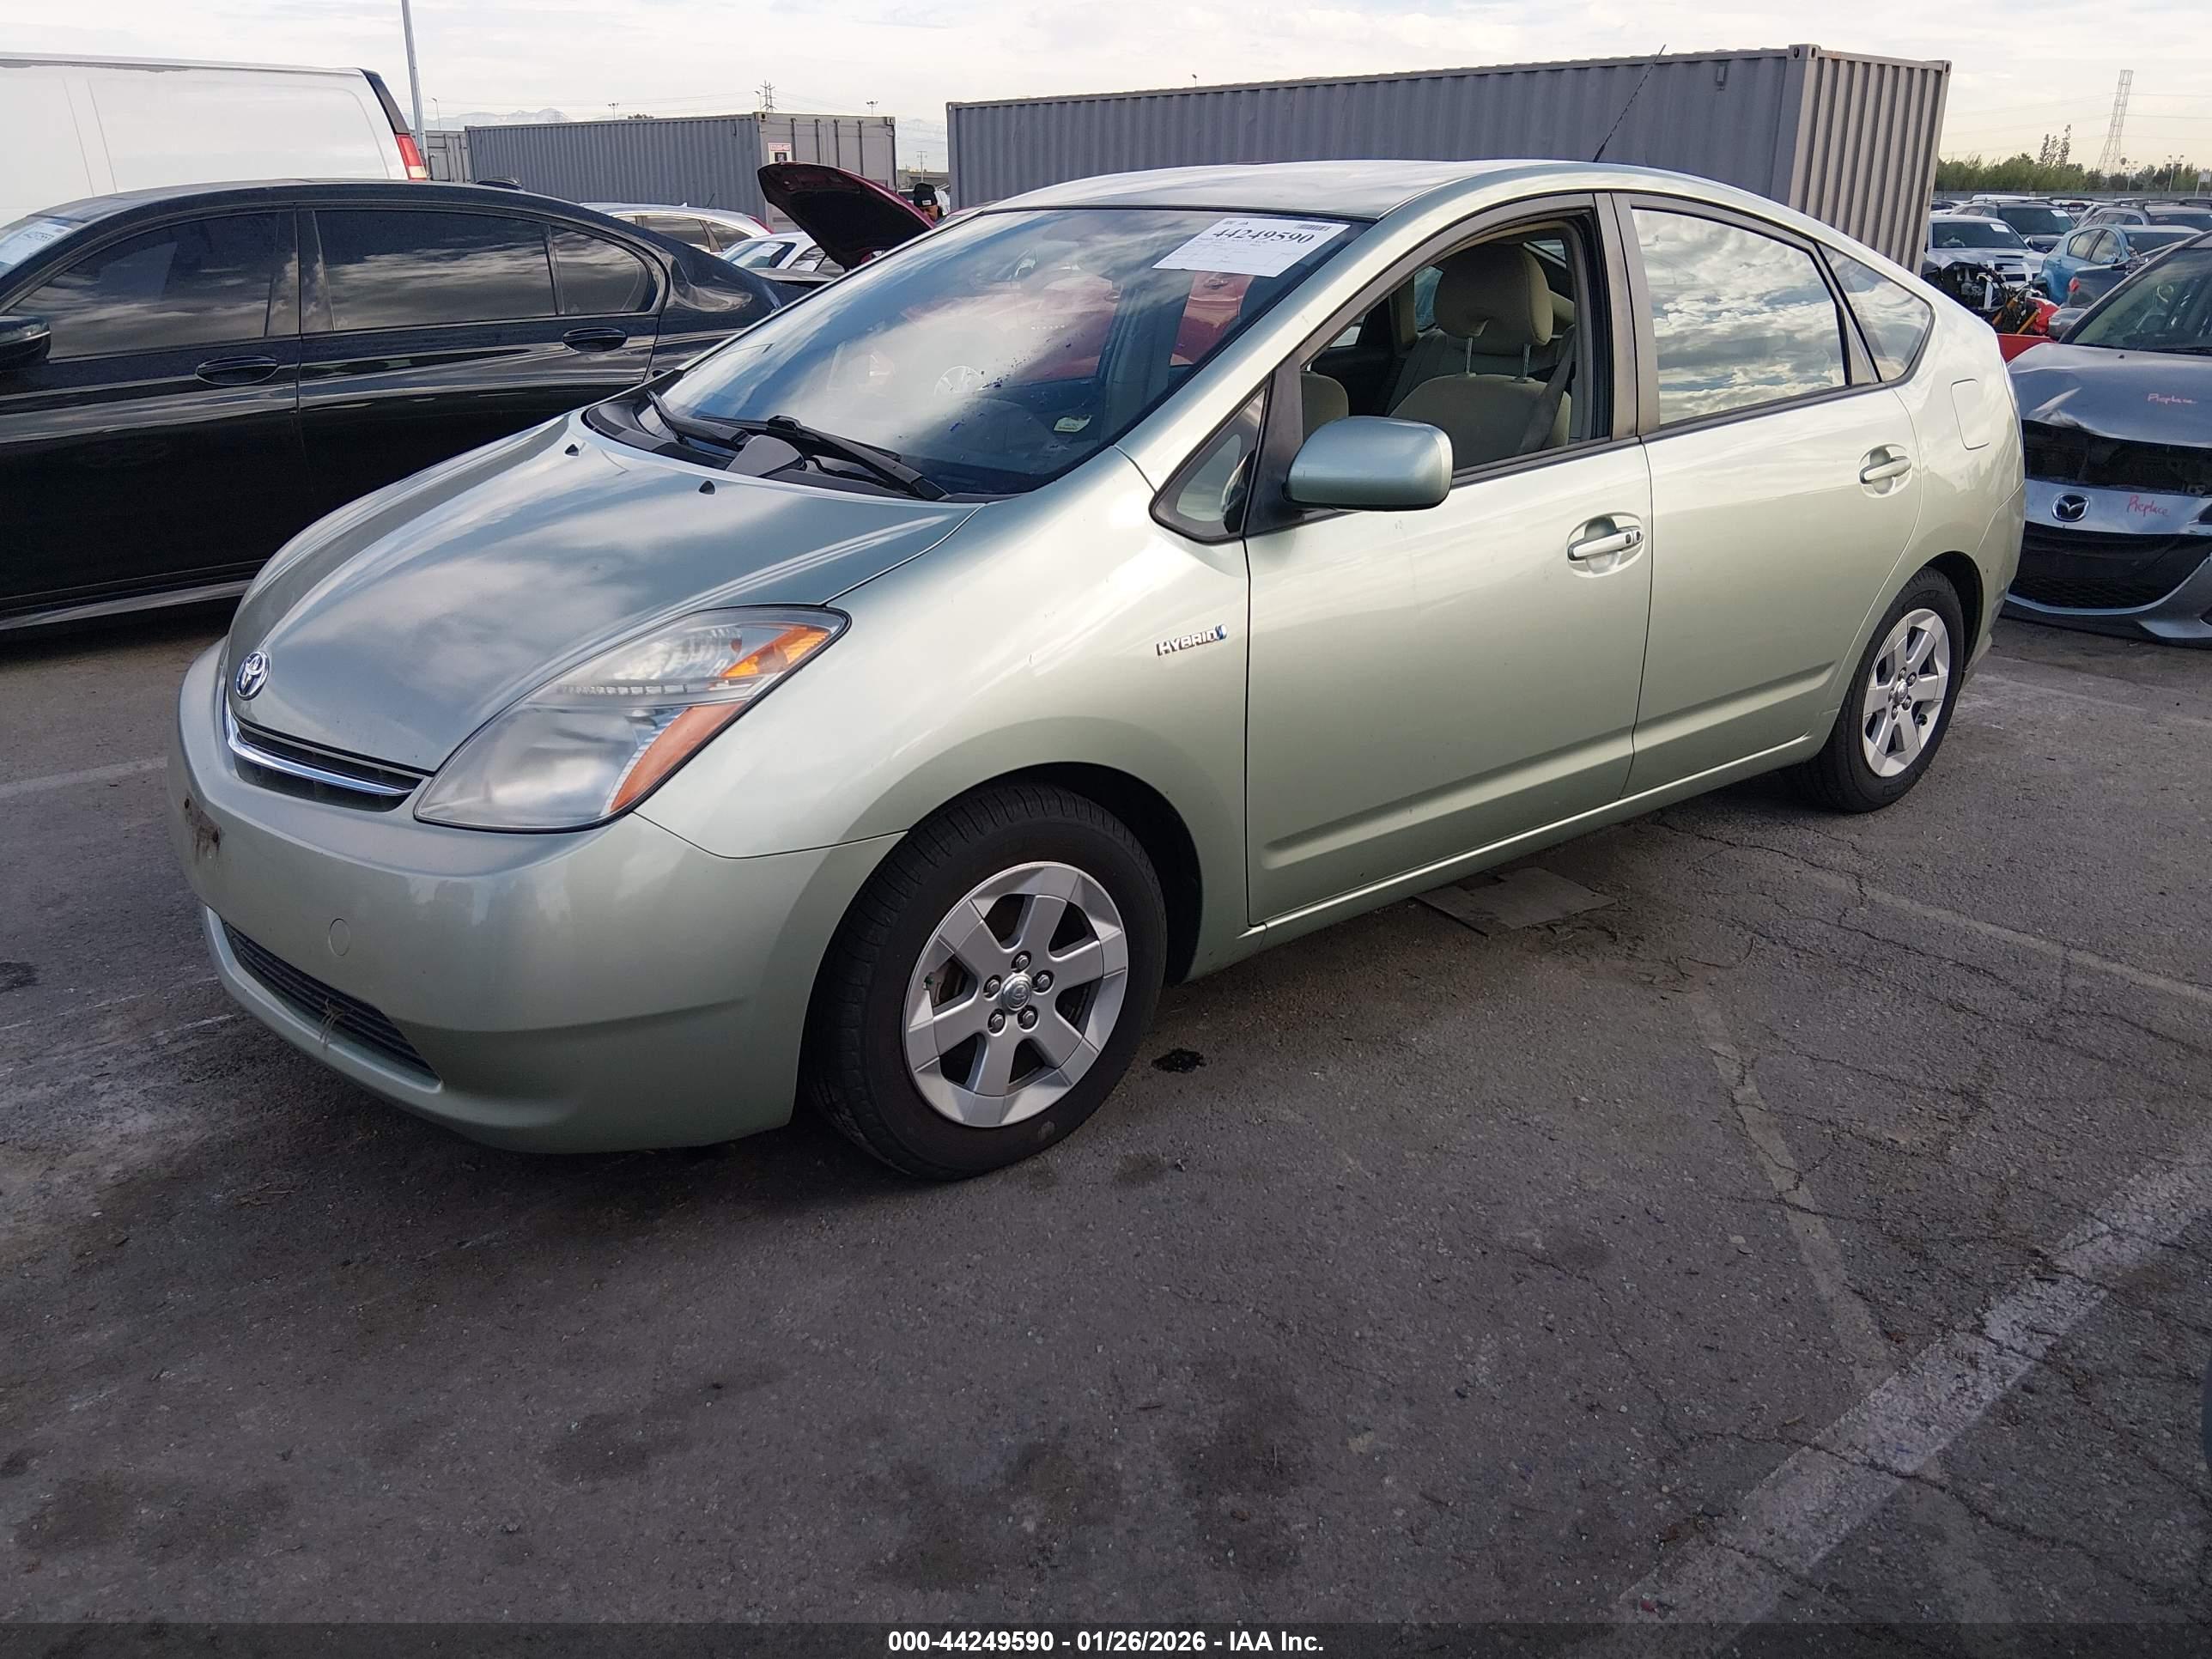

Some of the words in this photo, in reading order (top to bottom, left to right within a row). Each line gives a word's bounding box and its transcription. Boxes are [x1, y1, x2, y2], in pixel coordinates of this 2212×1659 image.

[1212, 228, 1315, 244] 44249590
[2127, 494, 2169, 518] Replace
[1156, 629, 1218, 656] HYBRID
